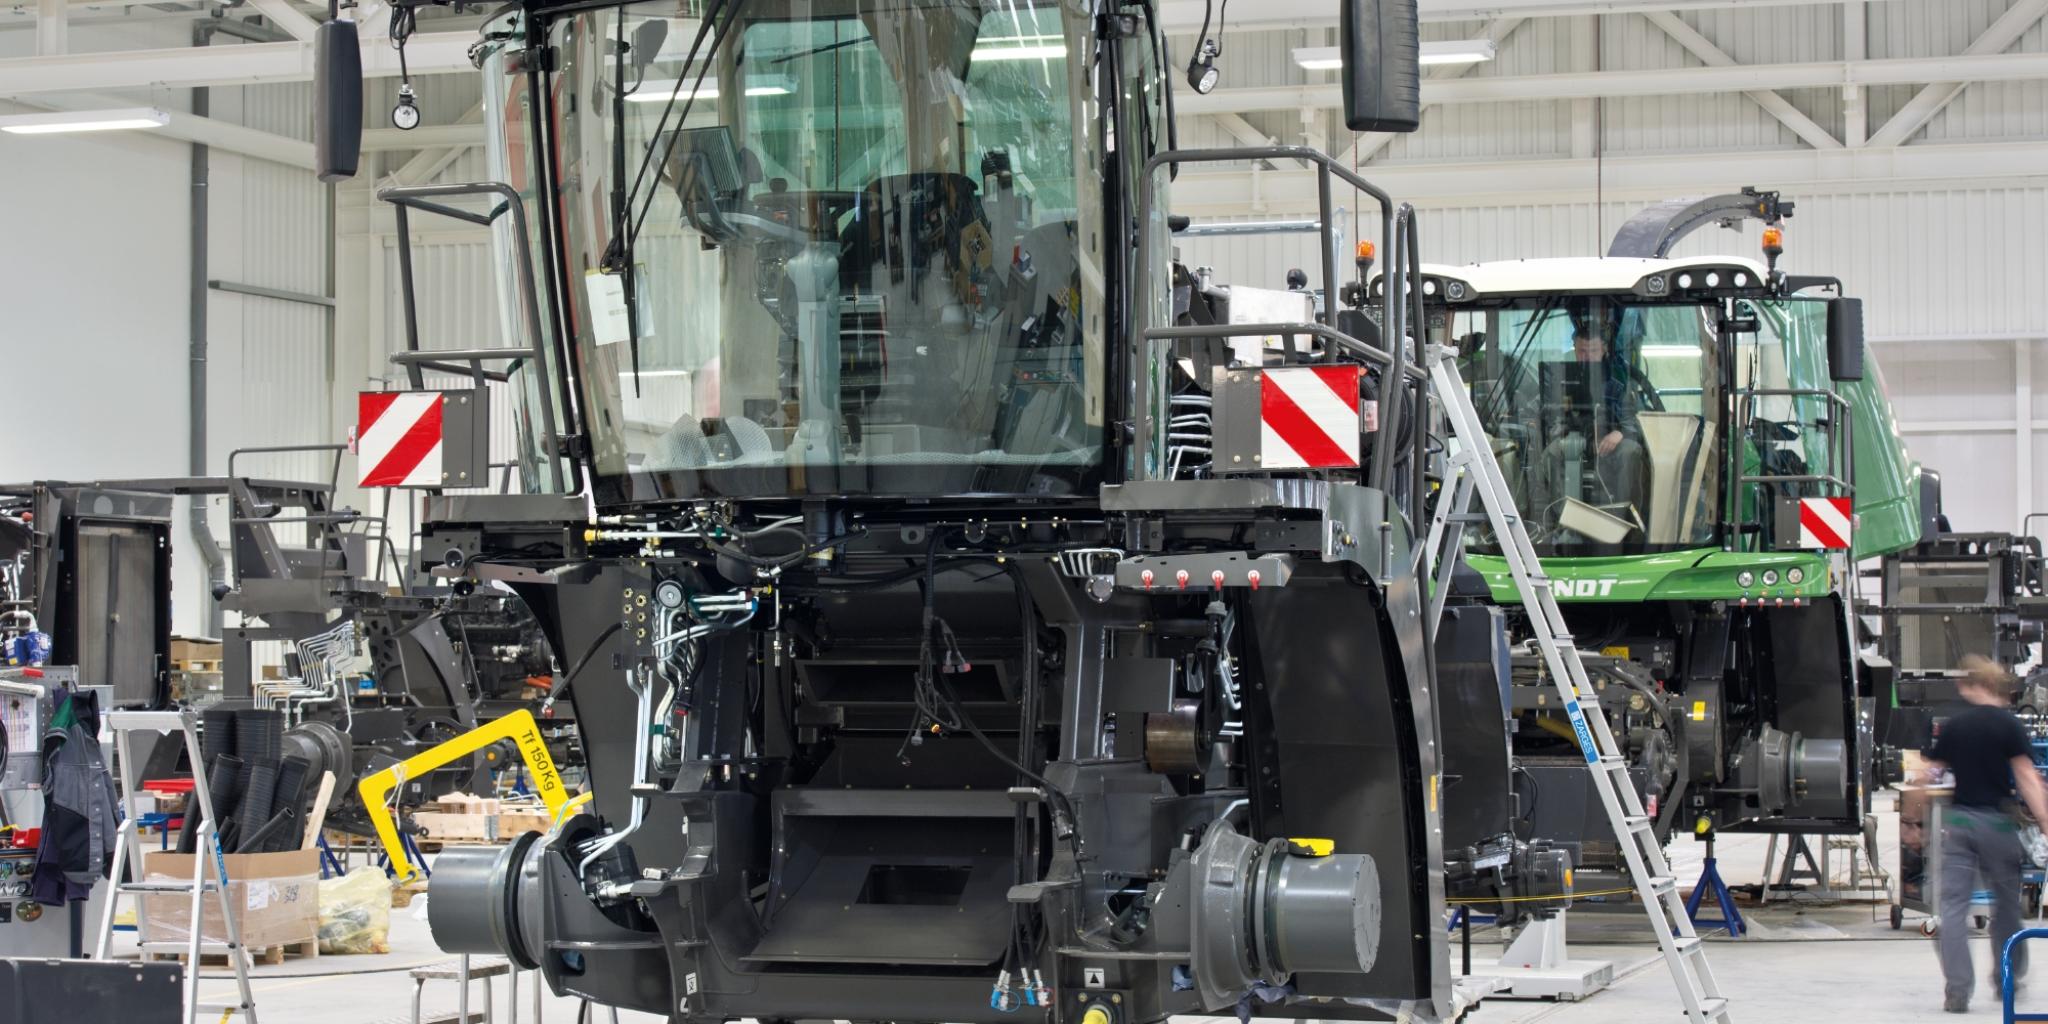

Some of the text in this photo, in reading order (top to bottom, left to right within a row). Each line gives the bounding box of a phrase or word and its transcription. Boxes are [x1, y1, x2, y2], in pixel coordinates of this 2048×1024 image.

[1546, 579, 1618, 597] NDT
[1575, 720, 1593, 754] ZARGES
[522, 729, 555, 792] Tf 150 Kg
